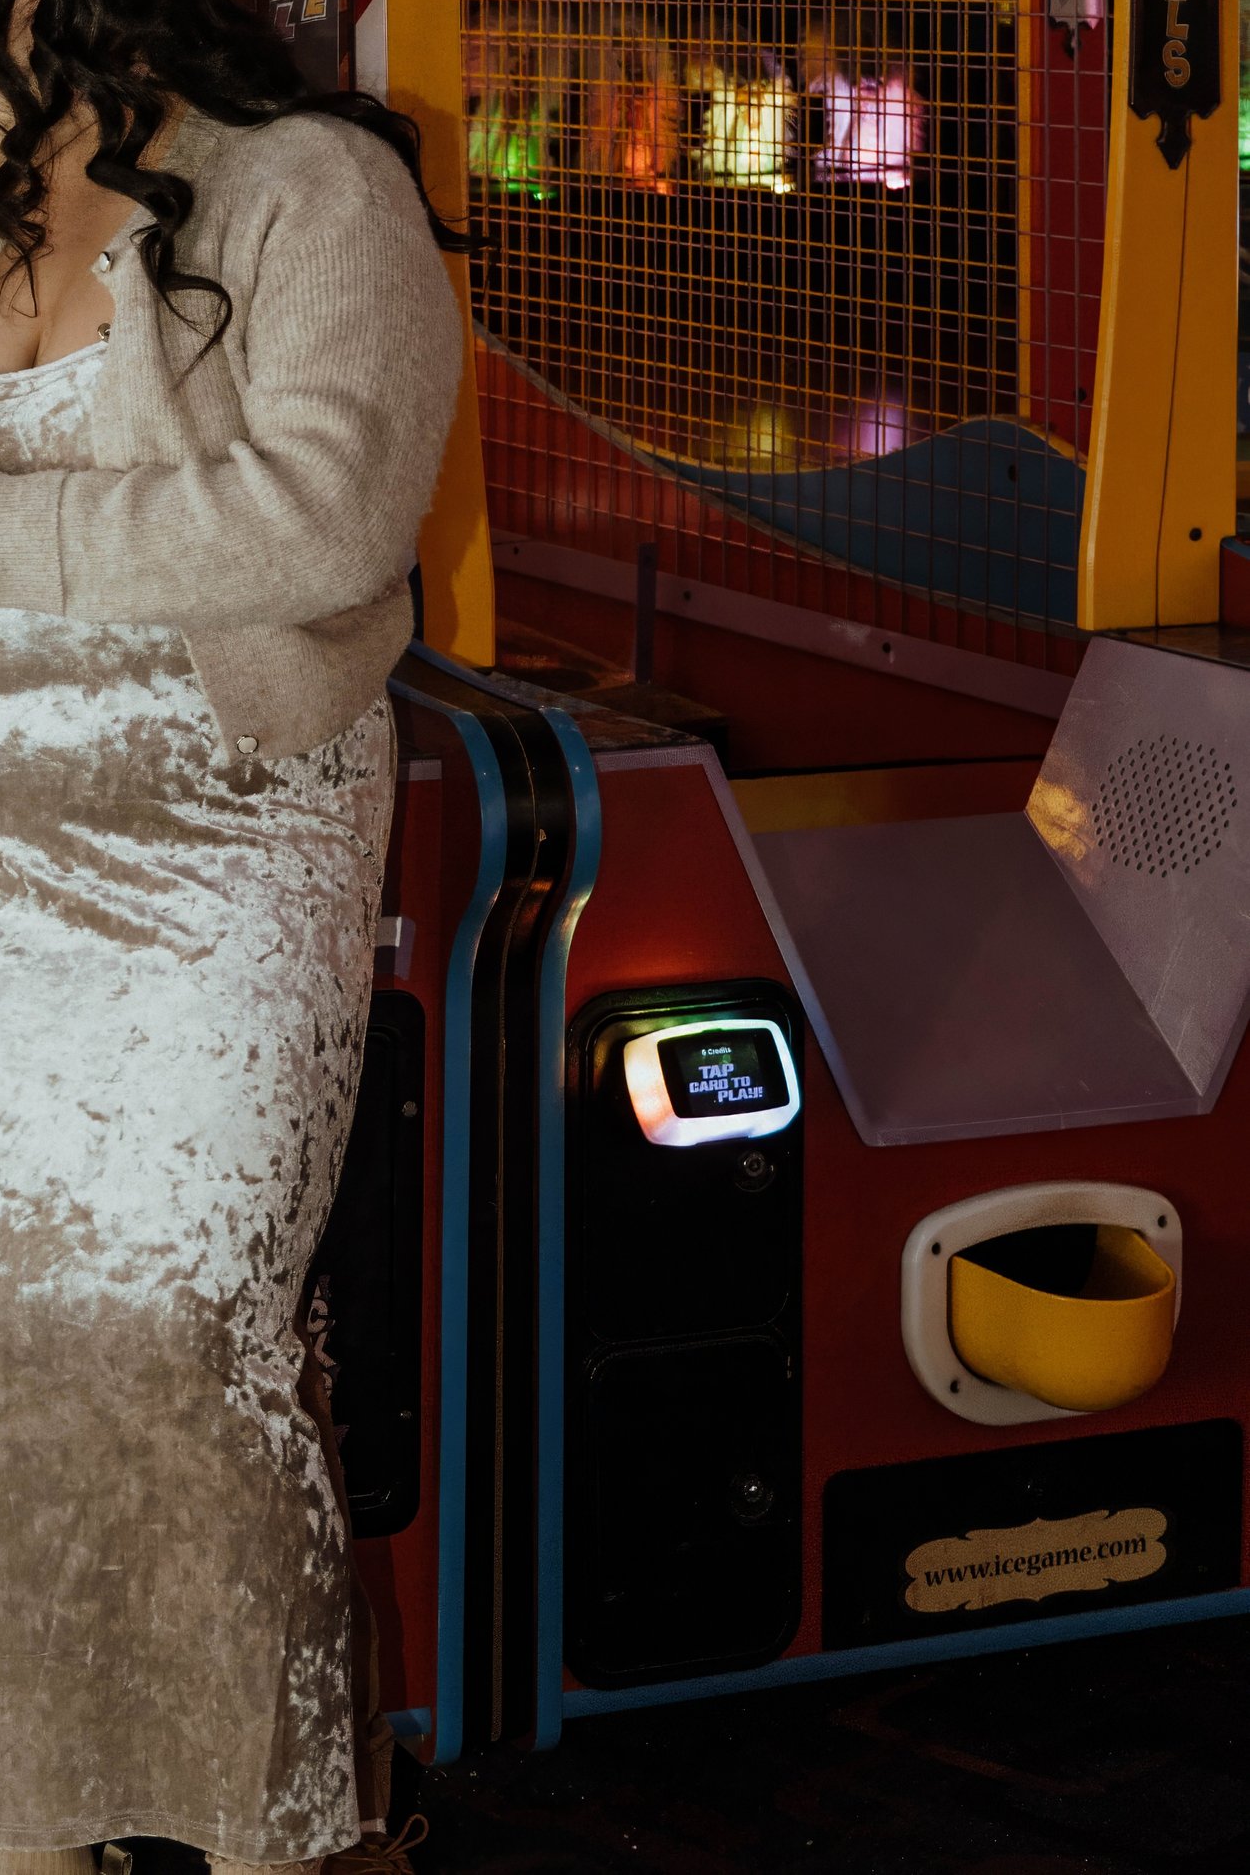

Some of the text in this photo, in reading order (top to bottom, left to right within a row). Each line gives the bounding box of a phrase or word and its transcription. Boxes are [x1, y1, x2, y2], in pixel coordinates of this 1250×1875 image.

[707, 1046, 732, 1055] Credits
[698, 1063, 734, 1079] TAP
[689, 1076, 750, 1093] CARD TO
[718, 1086, 763, 1102] PLAY!
[923, 1533, 1147, 1587] www.icegame.com
